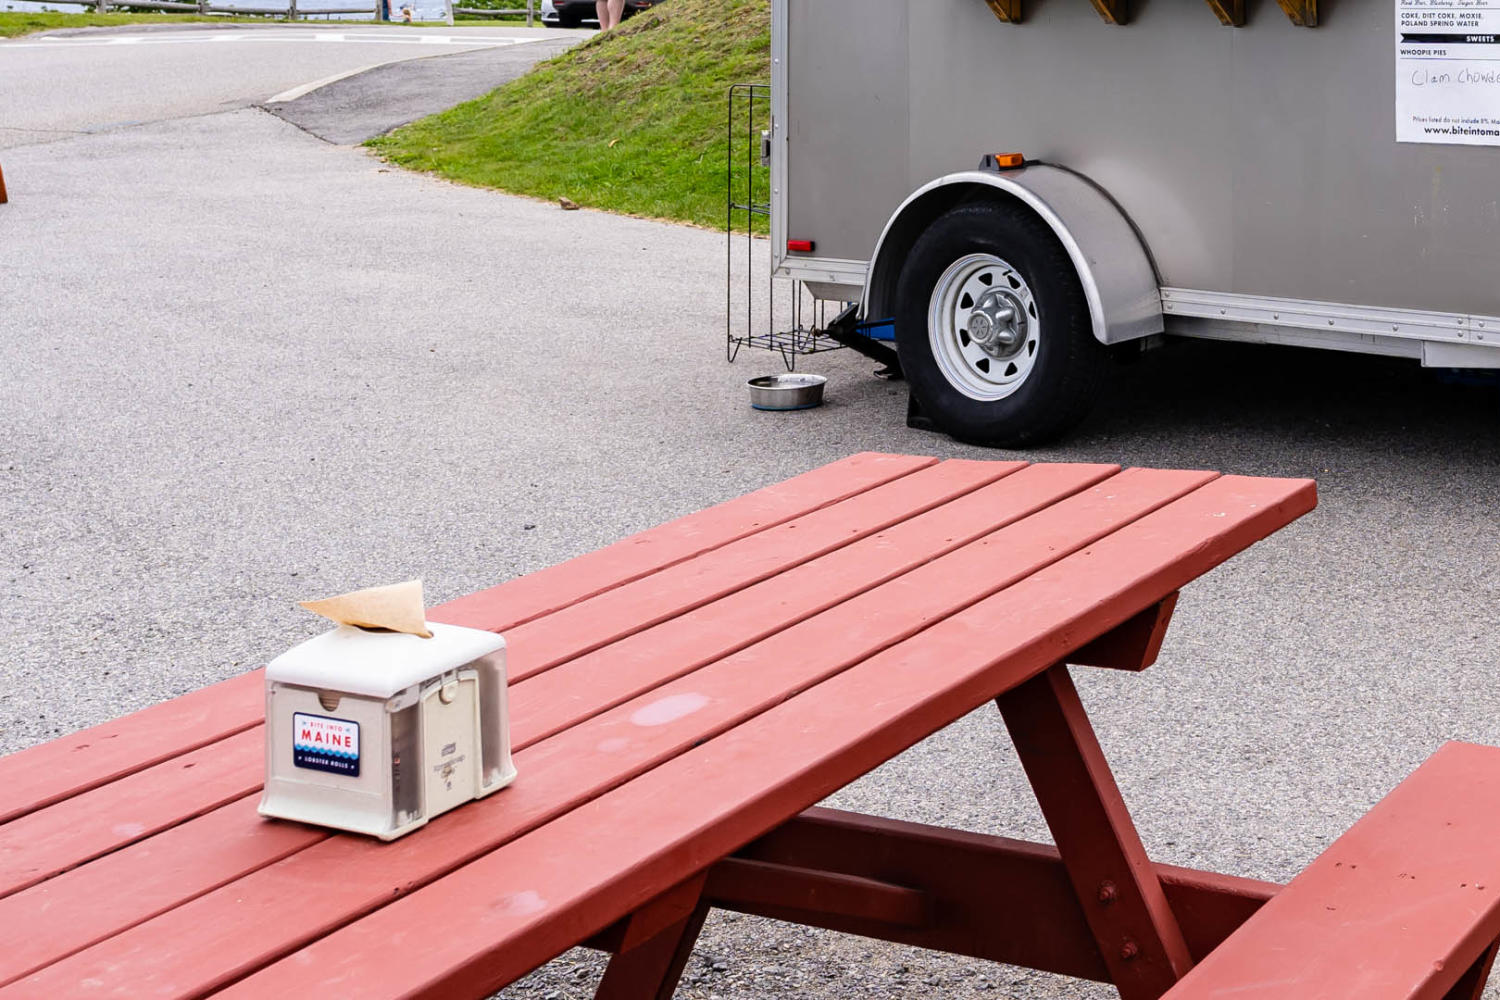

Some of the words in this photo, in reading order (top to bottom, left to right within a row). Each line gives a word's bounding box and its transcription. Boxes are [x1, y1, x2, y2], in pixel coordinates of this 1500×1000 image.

[1466, 35, 1495, 43] SWEETS
[1411, 69, 1449, 86] Clam
[302, 729, 351, 748] MAINE
[304, 756, 329, 764] LOBSTER
[330, 760, 348, 769] ROLLS
